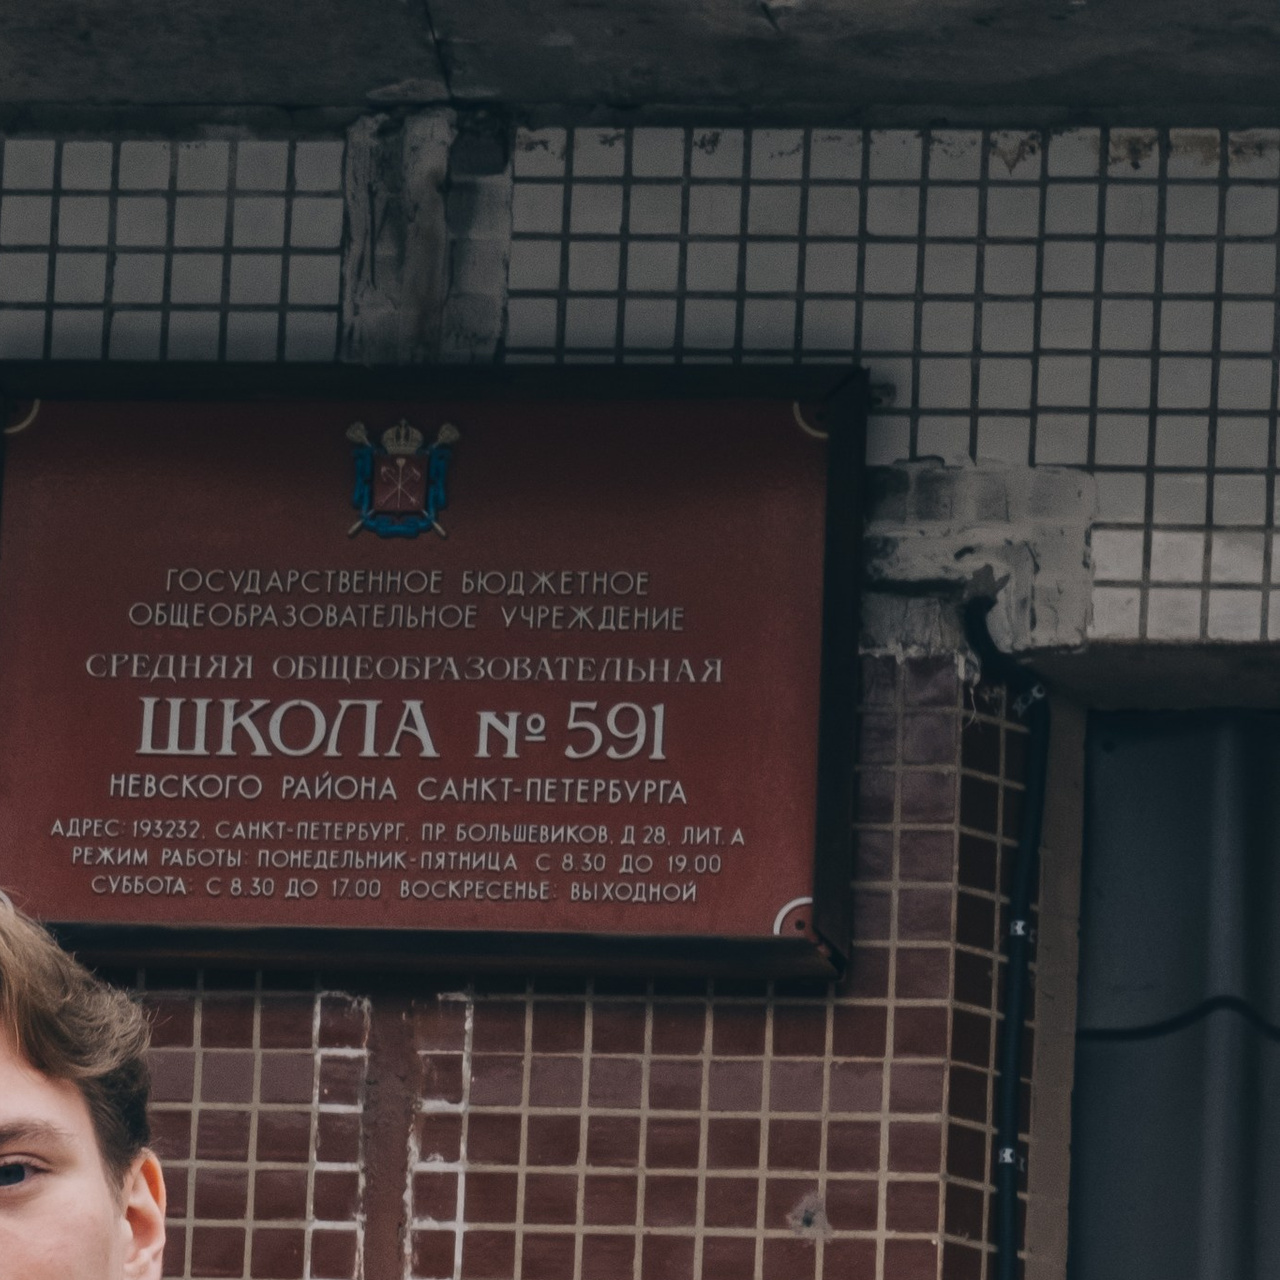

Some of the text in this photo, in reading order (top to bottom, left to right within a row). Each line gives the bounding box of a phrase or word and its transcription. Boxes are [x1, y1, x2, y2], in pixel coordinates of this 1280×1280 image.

[166, 568, 649, 596] ГОСУДАРСТВЕННОЕ БЮДЖЕТНОЕ
[128, 602, 685, 631] ОБЩЕОБРАЗОВАТЕЛЬНОЕ УЧРЕЖДЕНИЕ
[85, 653, 724, 684] СРЕДНЯЯ ОБЩЕОБРАЗОВАТЕЛЬНАЯ
[135, 696, 667, 760] ШКОЛА № 591
[109, 771, 688, 805] НЕВСКОГО РАЙОНА САНКТ-ПЕТЕРБУРГА
[50, 818, 125, 838] АДРЕС:
[456, 823, 613, 845] БОЛЬШЕВИКОВ,
[730, 828, 746, 846] А
[71, 846, 149, 867] РЕЖИМ
[161, 848, 249, 868] РАБОТЫ:
[535, 853, 552, 871] С
[561, 853, 606, 872] 8.30
[619, 854, 653, 874] ДО
[668, 854, 722, 874] 19.00
[91, 875, 698, 903] СУББОТА: С 8.30 ДО 17.00 ВОСКРЕСЕНЬЕ: ВЫХОДНОЙ
